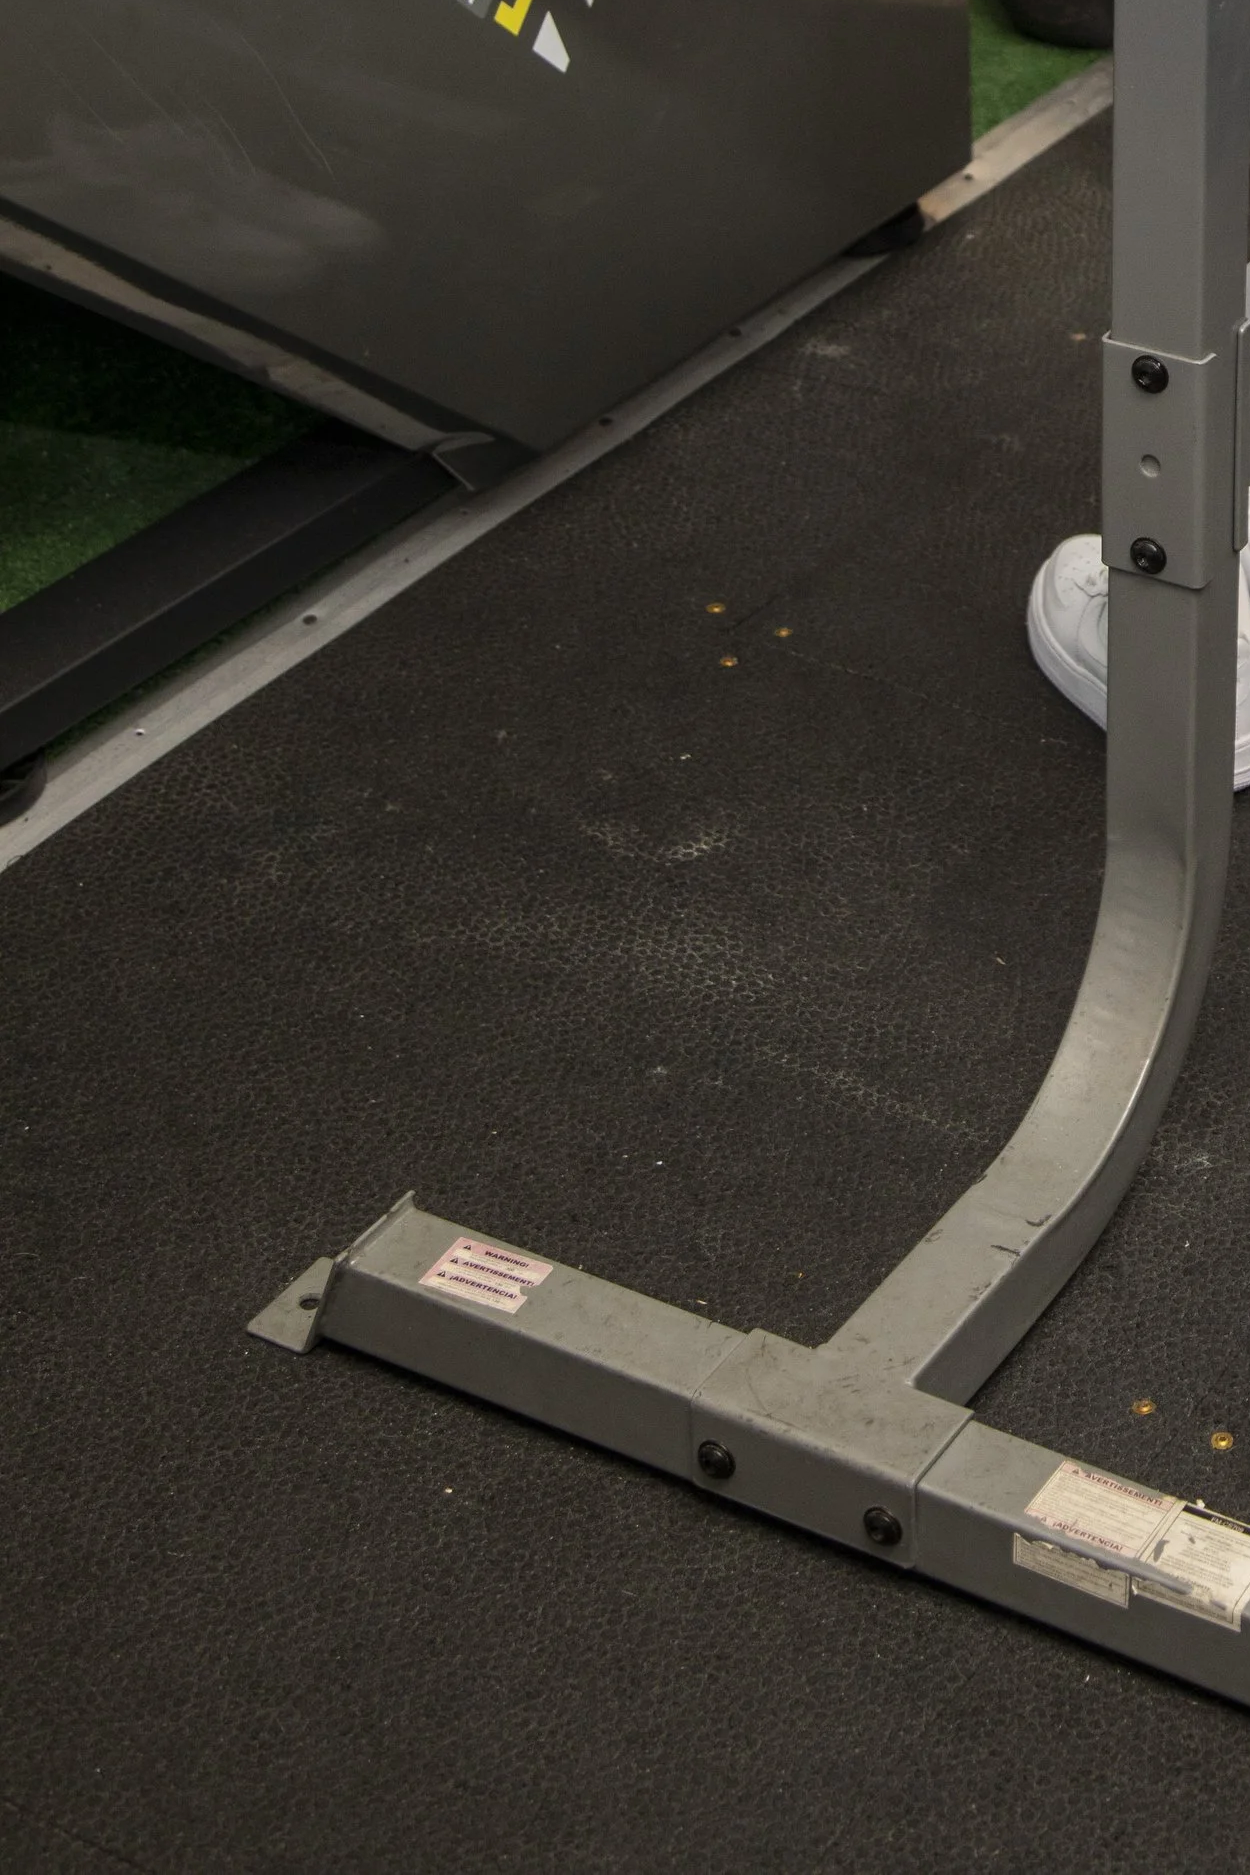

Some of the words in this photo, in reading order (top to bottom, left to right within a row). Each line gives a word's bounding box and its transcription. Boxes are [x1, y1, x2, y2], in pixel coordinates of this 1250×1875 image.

[485, 1250, 529, 1268] WARNING!
[463, 1260, 535, 1287] AVERTISSEMENT!
[449, 1275, 518, 1300] ¡ADVERTENCIA!
[1084, 1472, 1163, 1507] AVERTISSEMENT!
[1052, 1520, 1123, 1553] ¡ADVERTENCIA!
